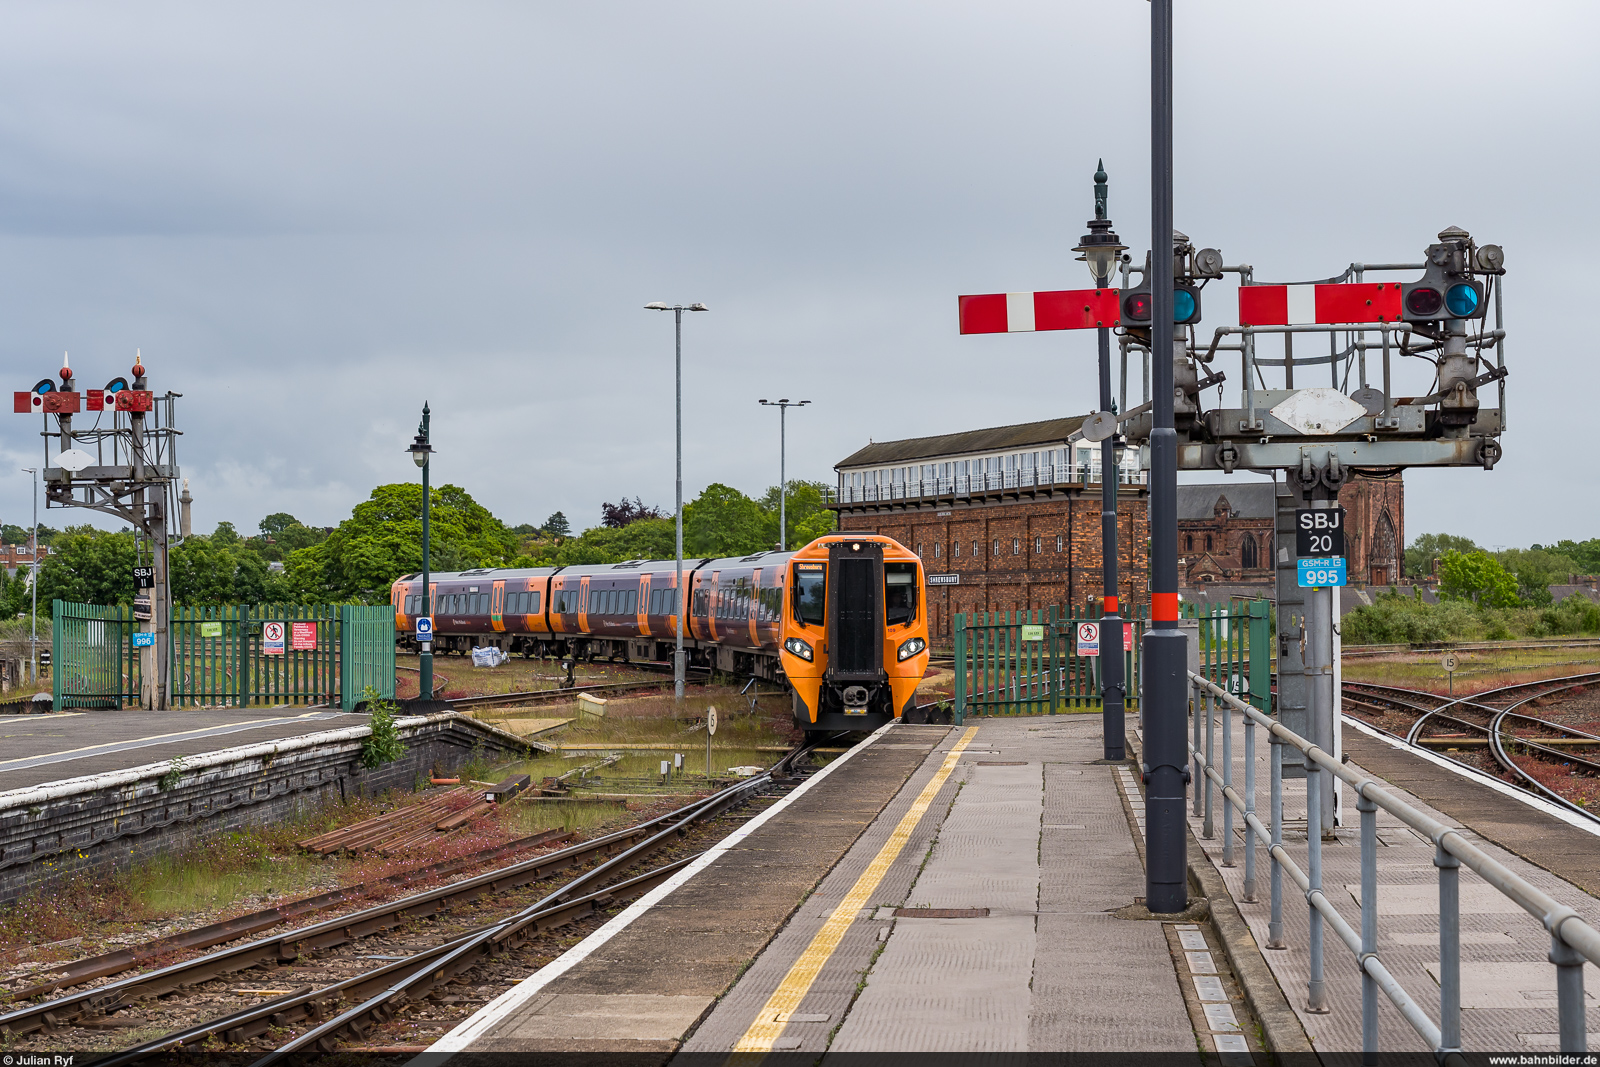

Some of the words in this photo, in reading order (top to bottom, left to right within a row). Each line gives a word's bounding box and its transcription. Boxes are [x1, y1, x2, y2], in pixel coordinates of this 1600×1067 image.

[1300, 513, 1339, 529] SBJ
[1309, 535, 1332, 552] 20
[134, 567, 152, 577] SBJ
[1306, 570, 1338, 585] 995
[930, 576, 957, 584] SHREWSBURY
[1446, 658, 1455, 667] 15
